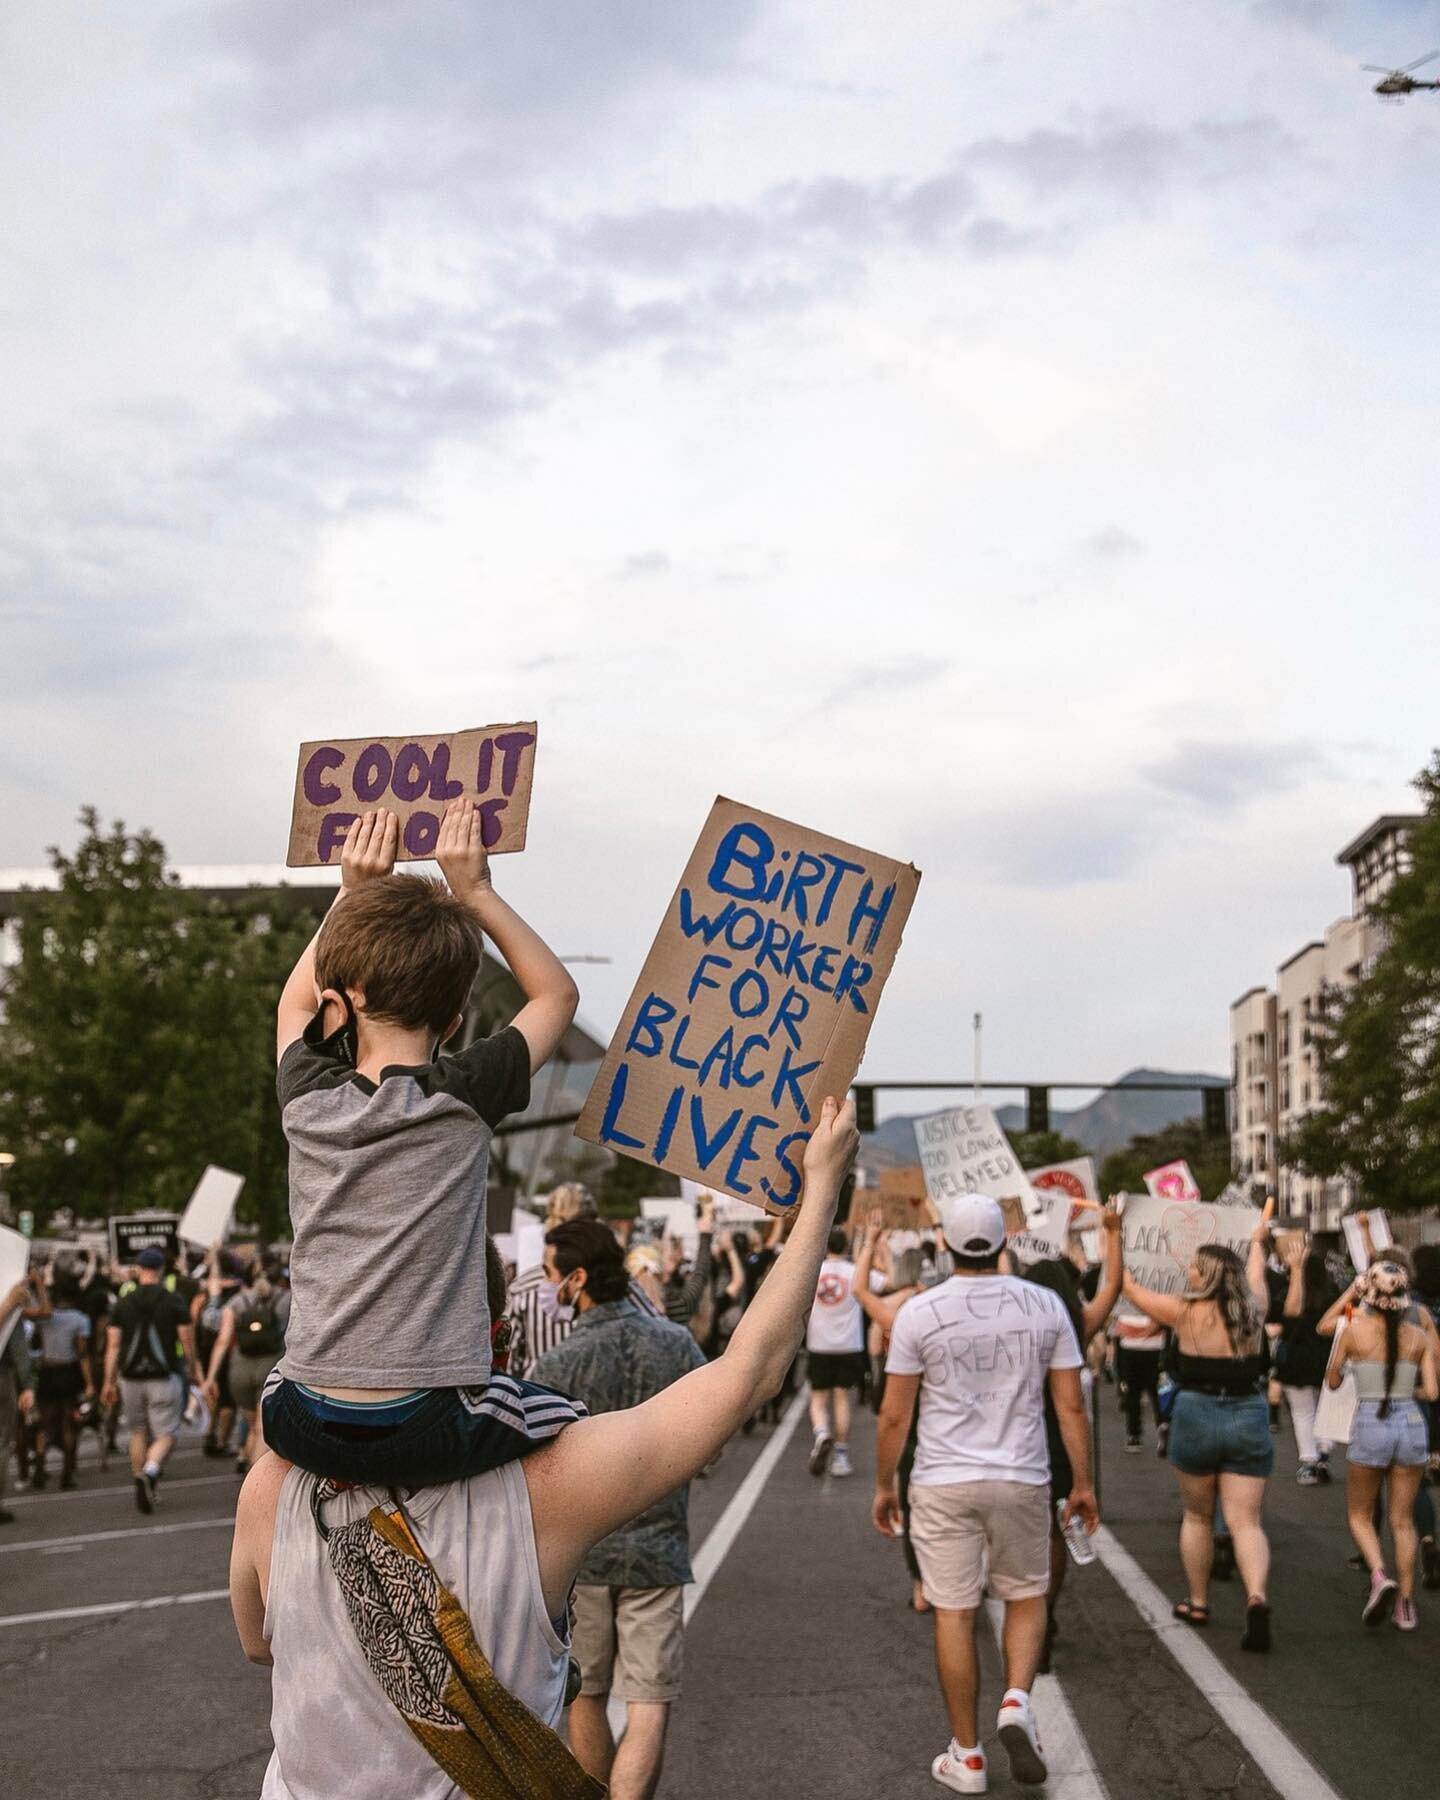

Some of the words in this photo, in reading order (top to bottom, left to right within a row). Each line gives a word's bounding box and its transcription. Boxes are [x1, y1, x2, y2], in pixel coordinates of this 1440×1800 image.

[304, 742, 463, 807] COOL
[477, 732, 535, 796] IT
[317, 798, 508, 863] FOS
[680, 888, 873, 1014] WORKER
[688, 955, 810, 1050] FOR
[625, 992, 824, 1124] BLACK
[599, 1063, 812, 1207] LIVES
[956, 1134, 1003, 1160] LONG
[929, 1155, 1014, 1200] DELAYED
[1122, 1224, 1172, 1257] LACK
